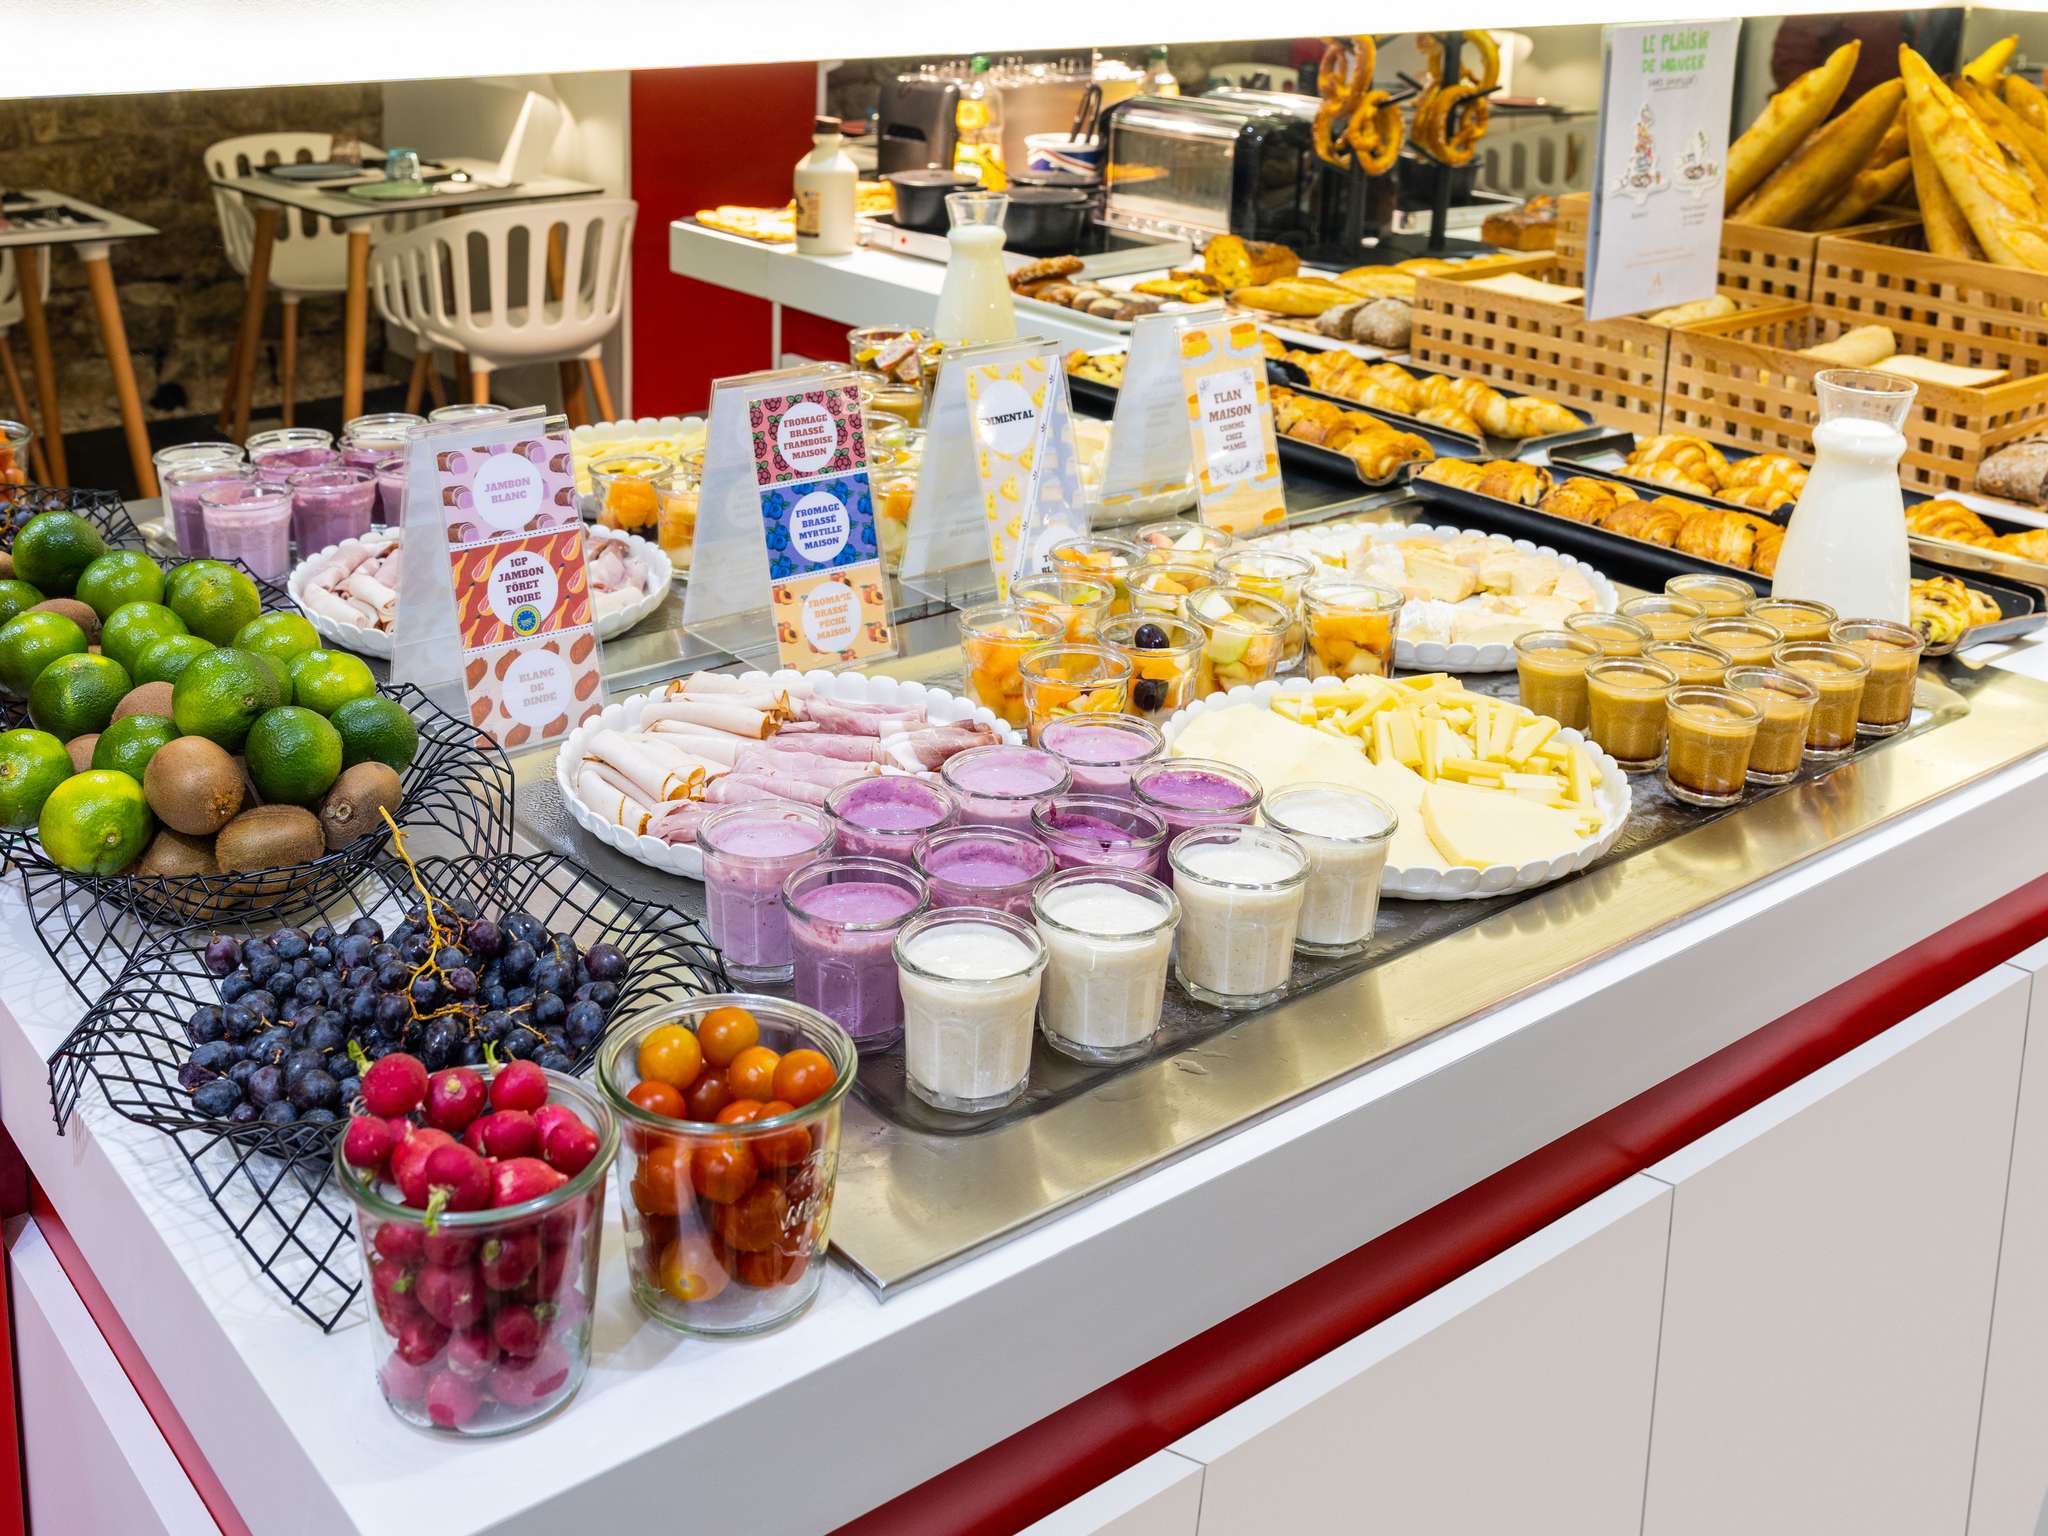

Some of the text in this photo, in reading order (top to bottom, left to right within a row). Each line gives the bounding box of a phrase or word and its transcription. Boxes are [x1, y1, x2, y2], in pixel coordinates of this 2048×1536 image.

[1213, 389, 1242, 404] FLAN
[1208, 404, 1252, 423] MAISON
[783, 414, 828, 428] FROMAGE
[783, 436, 833, 450] FRAMBOISE
[792, 448, 827, 460] MAISON
[484, 477, 531, 493] JAMBON
[491, 490, 528, 504] BLANC
[795, 503, 840, 518] FROMAGE
[799, 525, 843, 540] MYRTILLE
[804, 537, 840, 550] MAISON
[510, 557, 528, 567] IGP
[498, 566, 545, 583] JAMBON
[507, 592, 542, 606] NOIRE
[519, 668, 556, 683] BLANC
[530, 683, 545, 693] DE
[523, 692, 558, 707] DINDE
